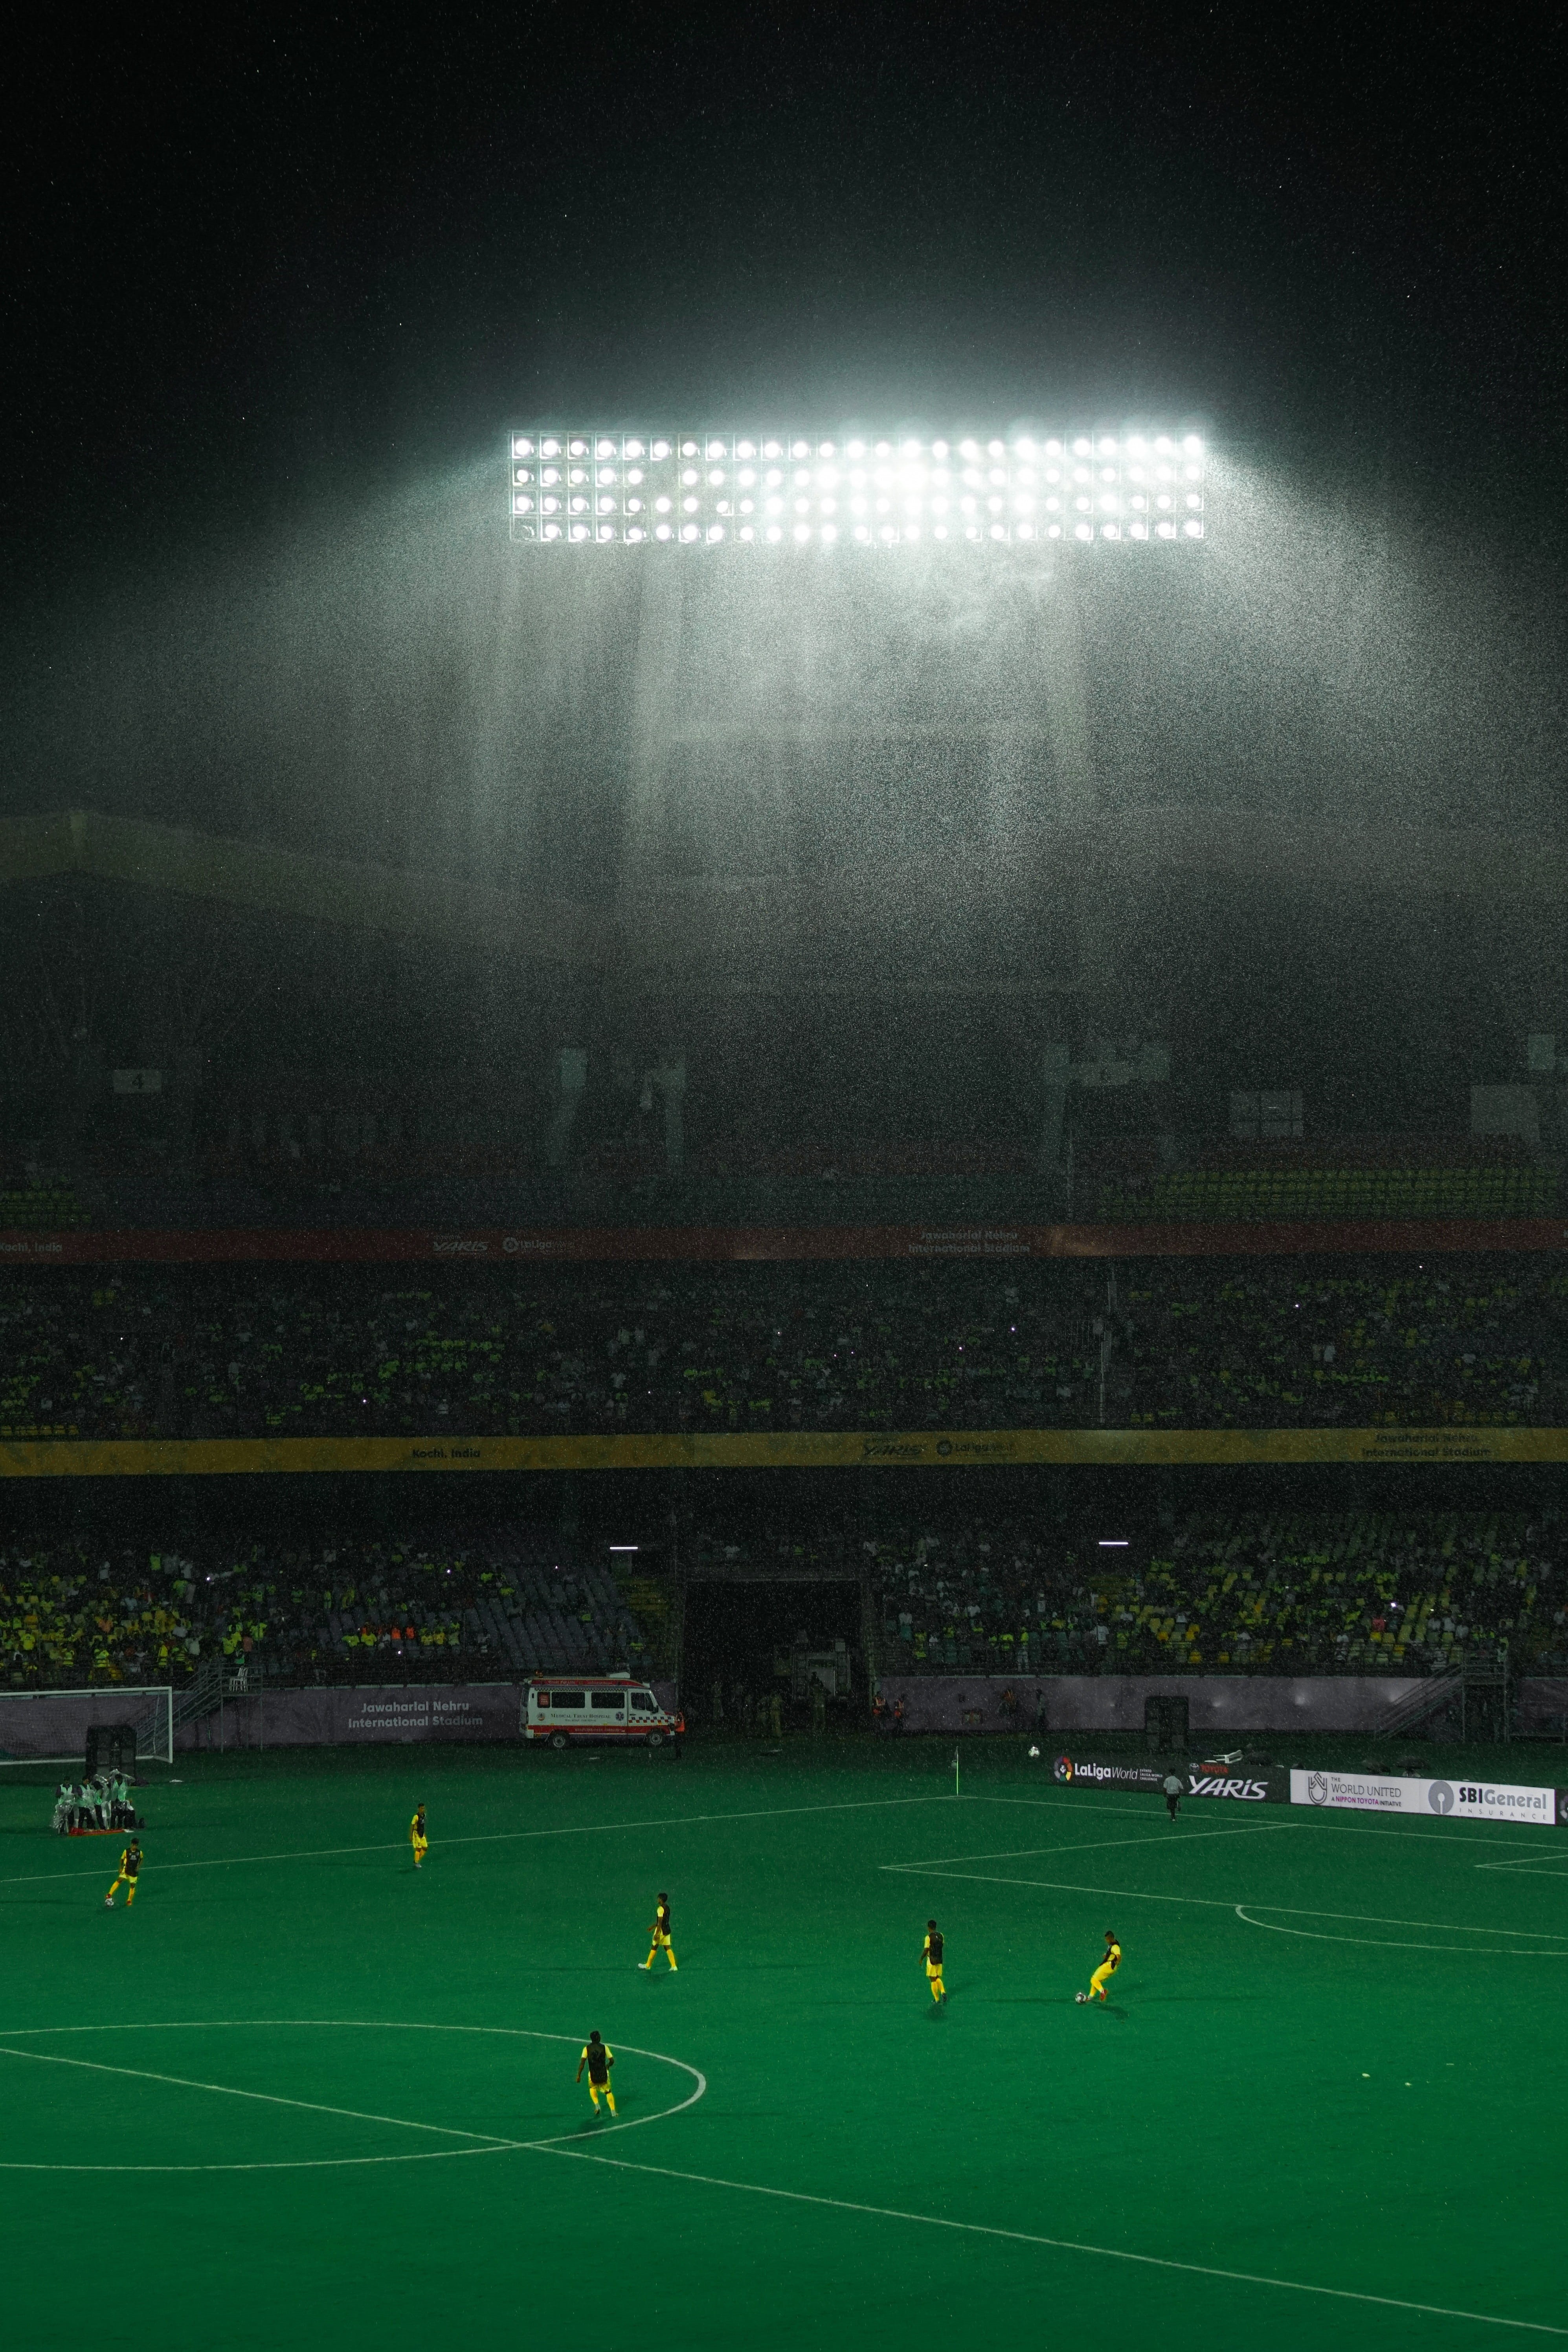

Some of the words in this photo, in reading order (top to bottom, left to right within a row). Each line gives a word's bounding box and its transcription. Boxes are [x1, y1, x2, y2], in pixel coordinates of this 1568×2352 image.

[920, 1230, 980, 1239] Jawaharlal
[985, 1230, 1018, 1239] Nehru
[35, 1242, 62, 1252] India
[908, 1244, 981, 1253] International
[984, 1244, 1030, 1253] Stadium
[1375, 1433, 1439, 1443] Jawaharlal
[1443, 1432, 1478, 1442] Nehru
[413, 1448, 447, 1458] Kochi,
[451, 1448, 481, 1458] India
[1362, 1448, 1439, 1457] International
[1442, 1447, 1491, 1457] Stadium
[361, 1701, 429, 1713] Jawaharlal
[433, 1700, 469, 1711] Nehru
[348, 1715, 429, 1728] International
[432, 1715, 483, 1726] Stadium
[1331, 1783, 1364, 1795] WORLD
[1367, 1786, 1401, 1798] UNITED
[1460, 1808, 1546, 1820] INSURANCE
